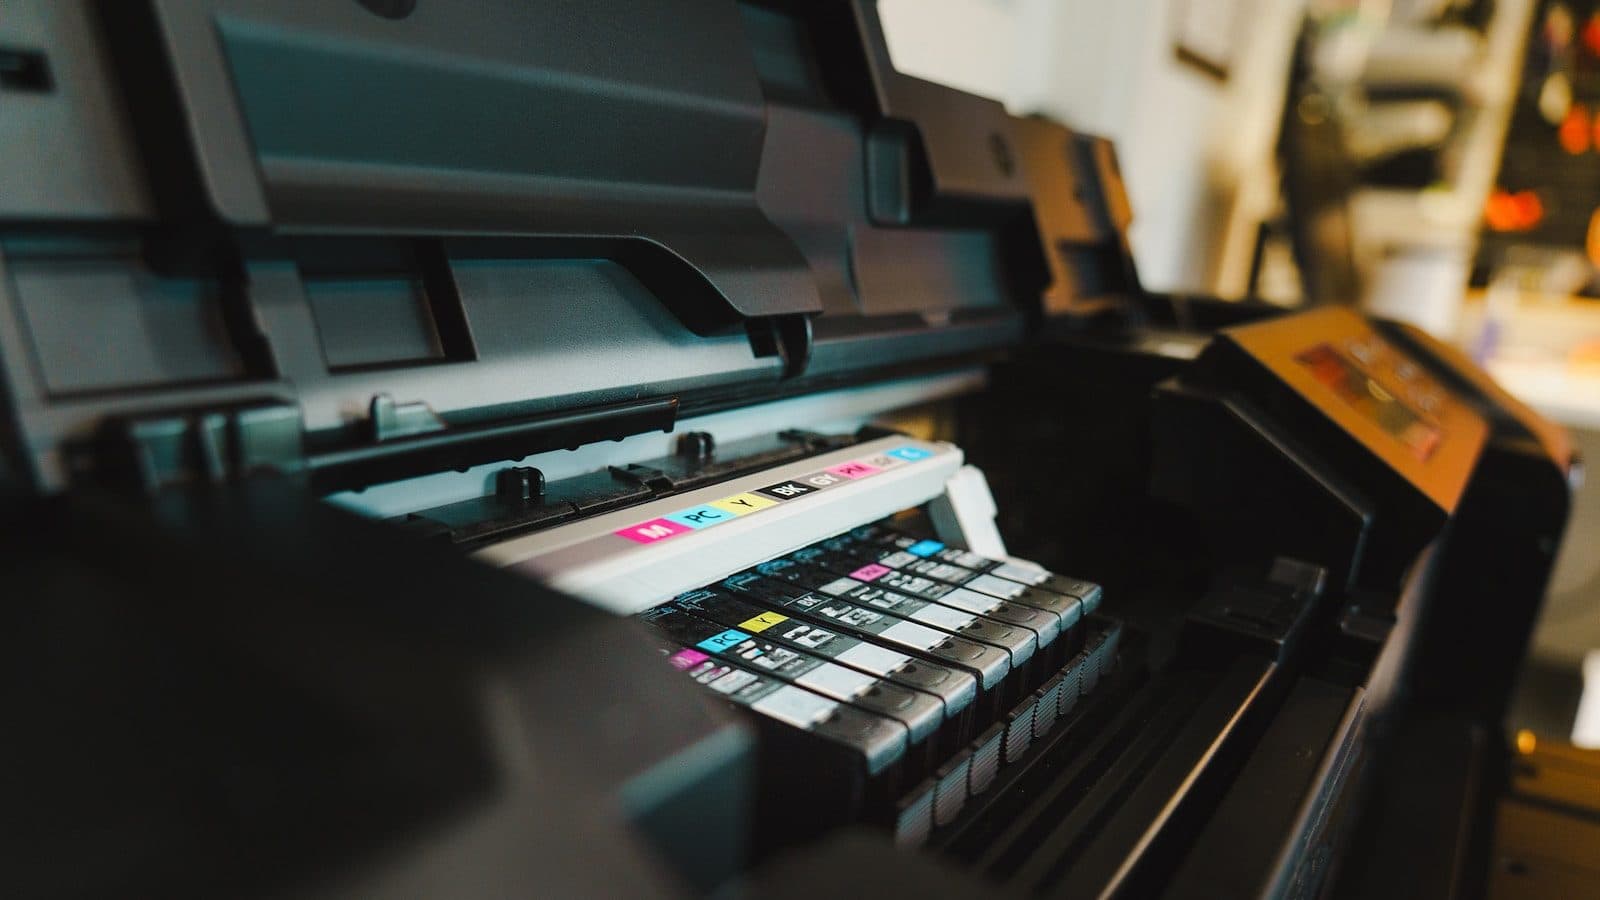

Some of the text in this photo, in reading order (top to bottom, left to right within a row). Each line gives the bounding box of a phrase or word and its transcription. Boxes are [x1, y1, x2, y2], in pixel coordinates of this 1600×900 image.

[636, 524, 674, 539] M
[683, 510, 722, 523] PC
[730, 499, 754, 507] Y
[771, 484, 808, 497] BK
[809, 473, 839, 486] GY
[797, 596, 822, 606] BK
[754, 617, 771, 625] Y
[712, 634, 739, 646] PC
